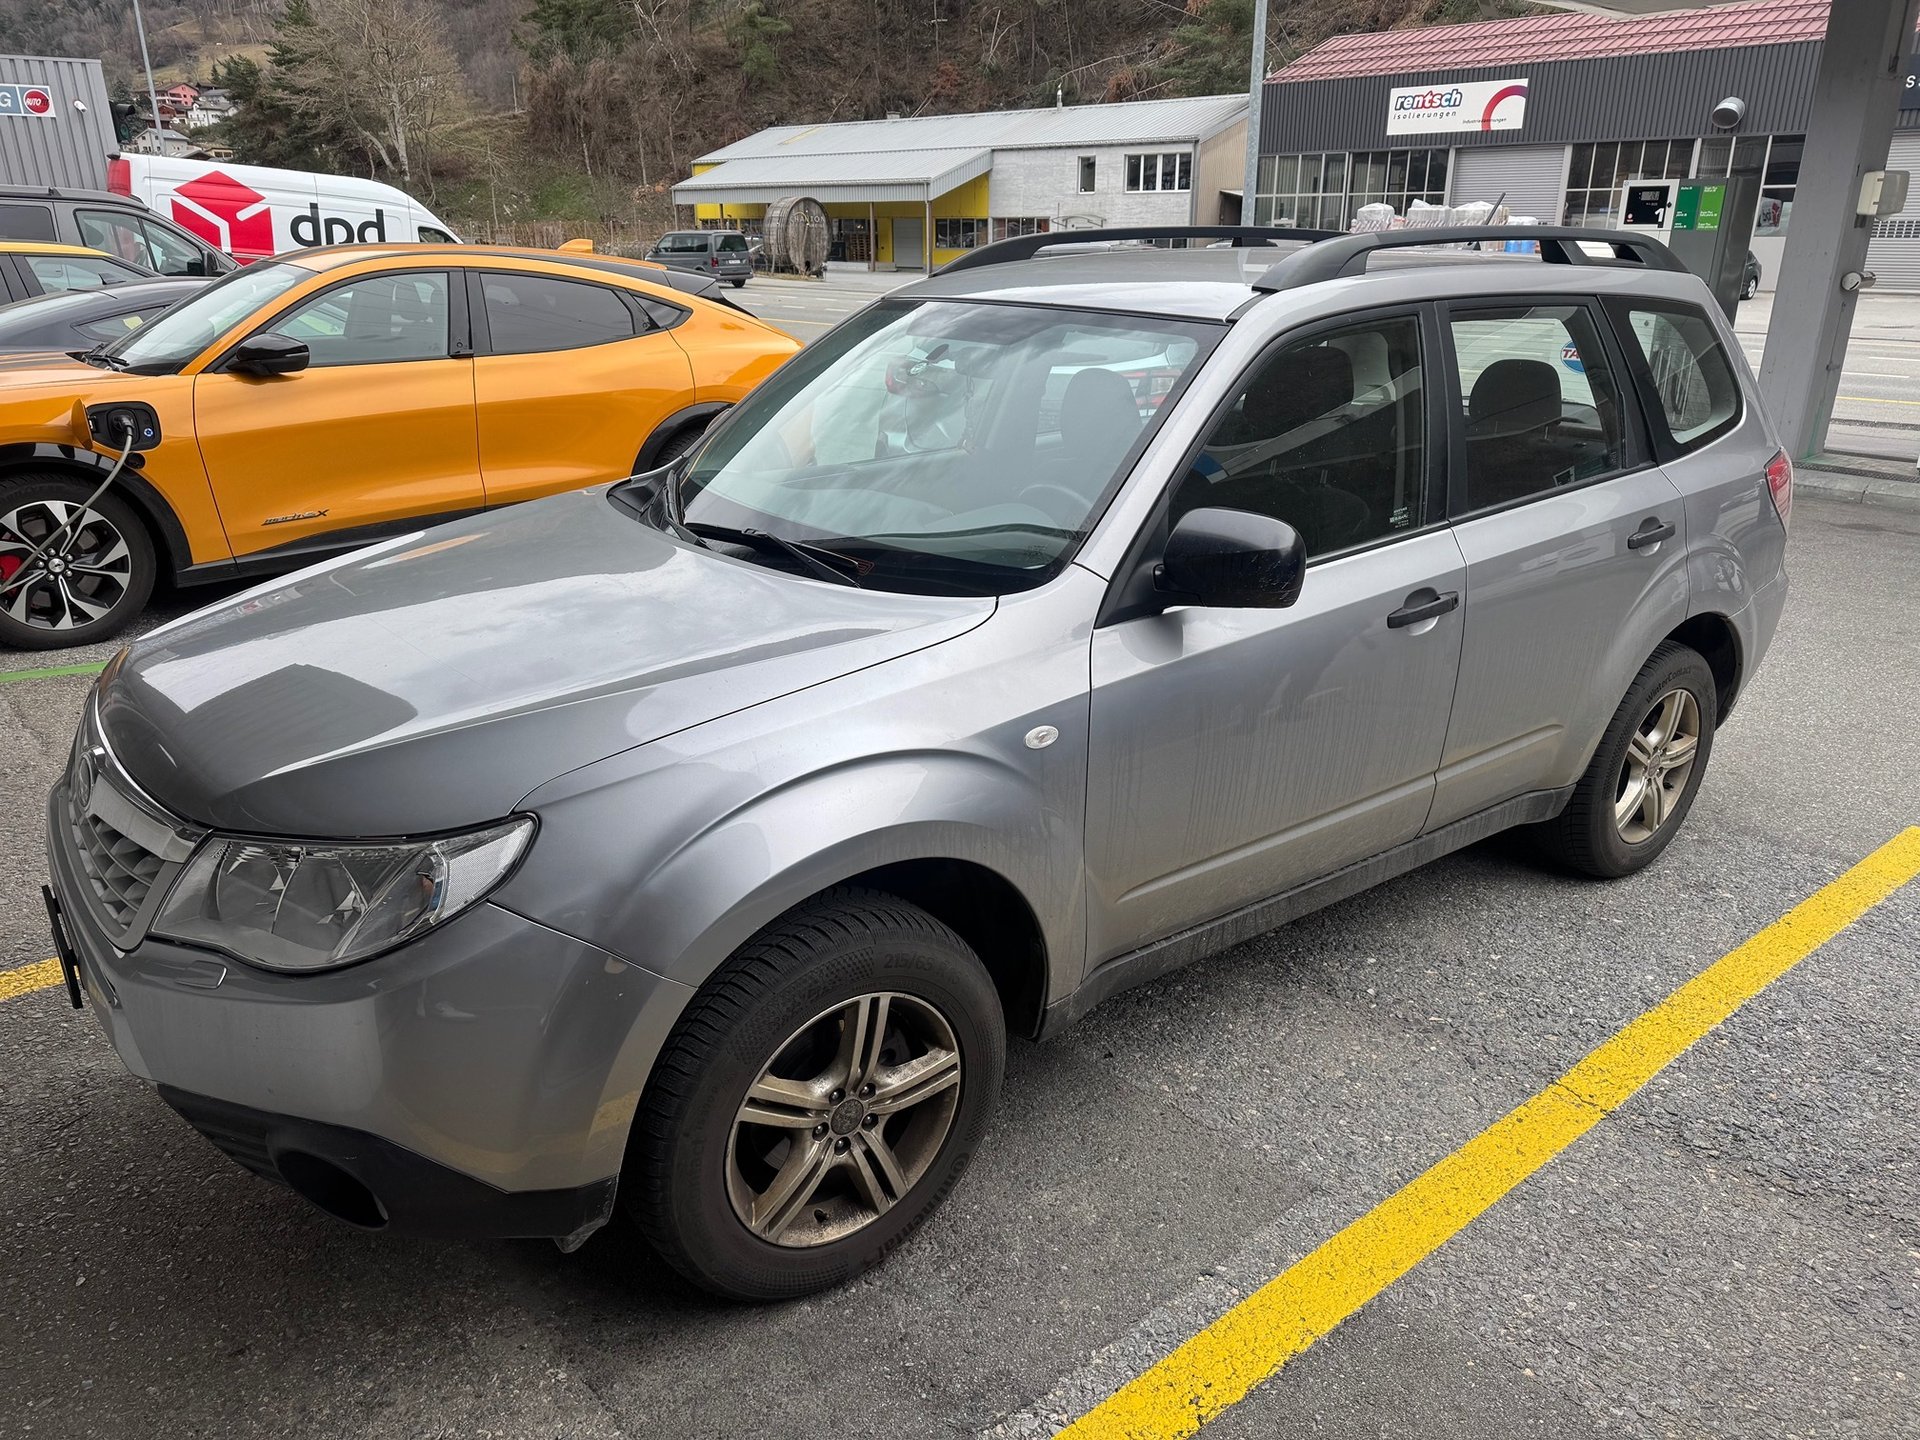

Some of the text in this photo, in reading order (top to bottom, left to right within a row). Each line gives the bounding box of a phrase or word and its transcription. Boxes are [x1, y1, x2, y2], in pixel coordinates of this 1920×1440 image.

[1395, 89, 1462, 111] rentsch
[1393, 111, 1456, 120] isolierungen
[290, 202, 386, 247] dpd
[1654, 207, 1665, 228] 1
